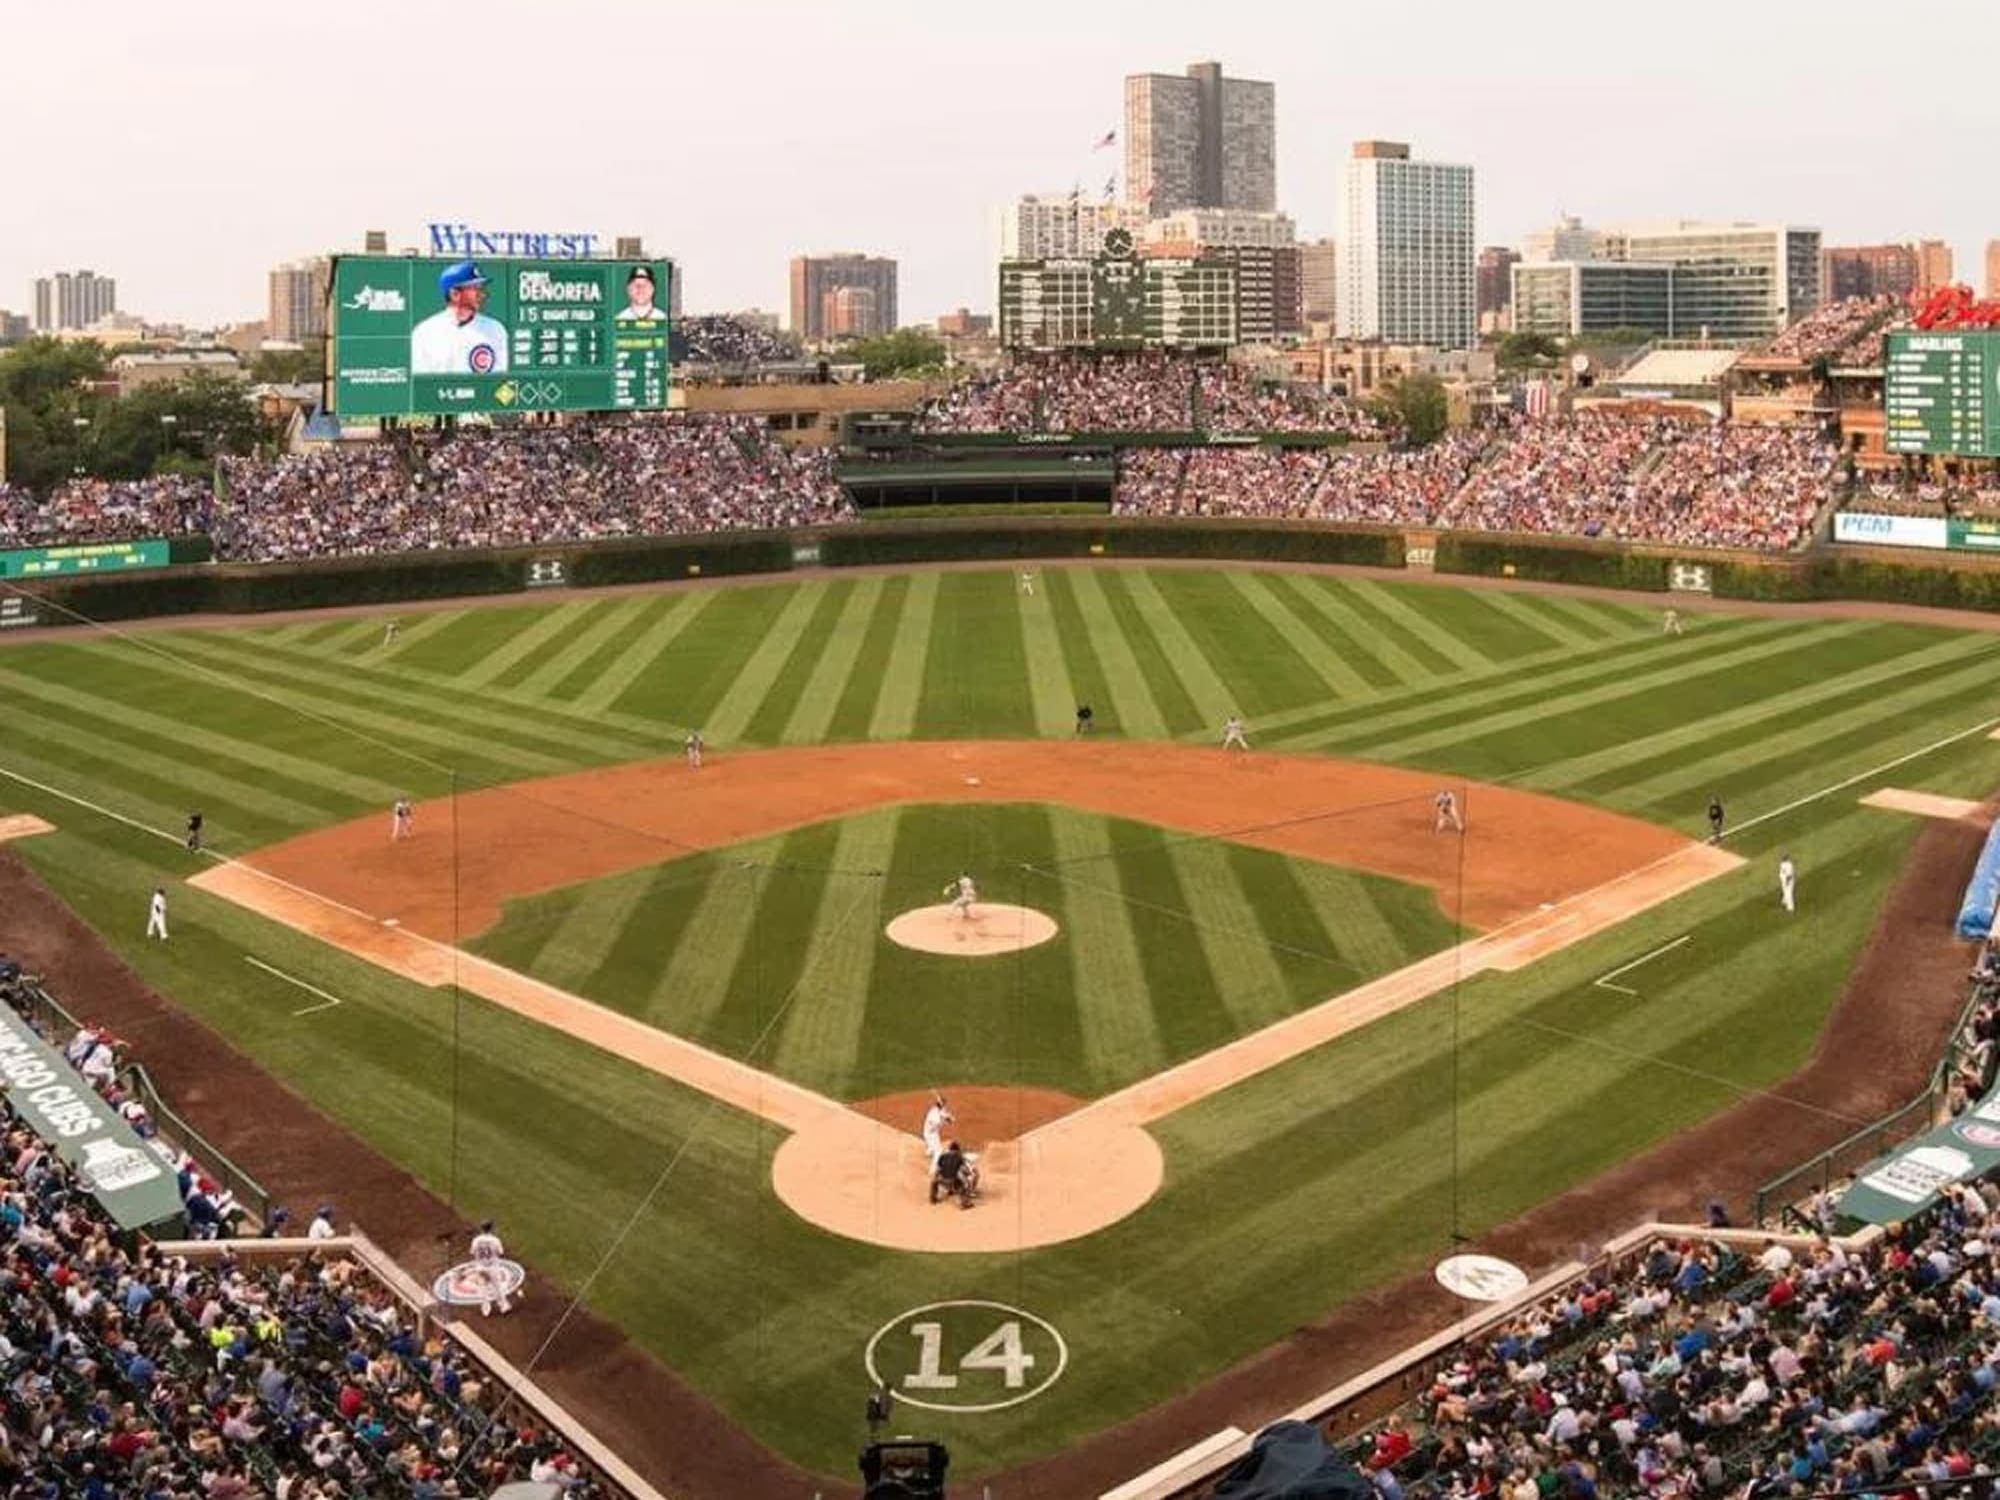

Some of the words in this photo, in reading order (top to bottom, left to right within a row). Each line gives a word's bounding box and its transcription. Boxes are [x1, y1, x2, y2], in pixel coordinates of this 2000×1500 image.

[519, 281, 602, 301] DENORFIA
[28, 1086, 103, 1137] CUBS
[903, 1322, 1035, 1388] 14
